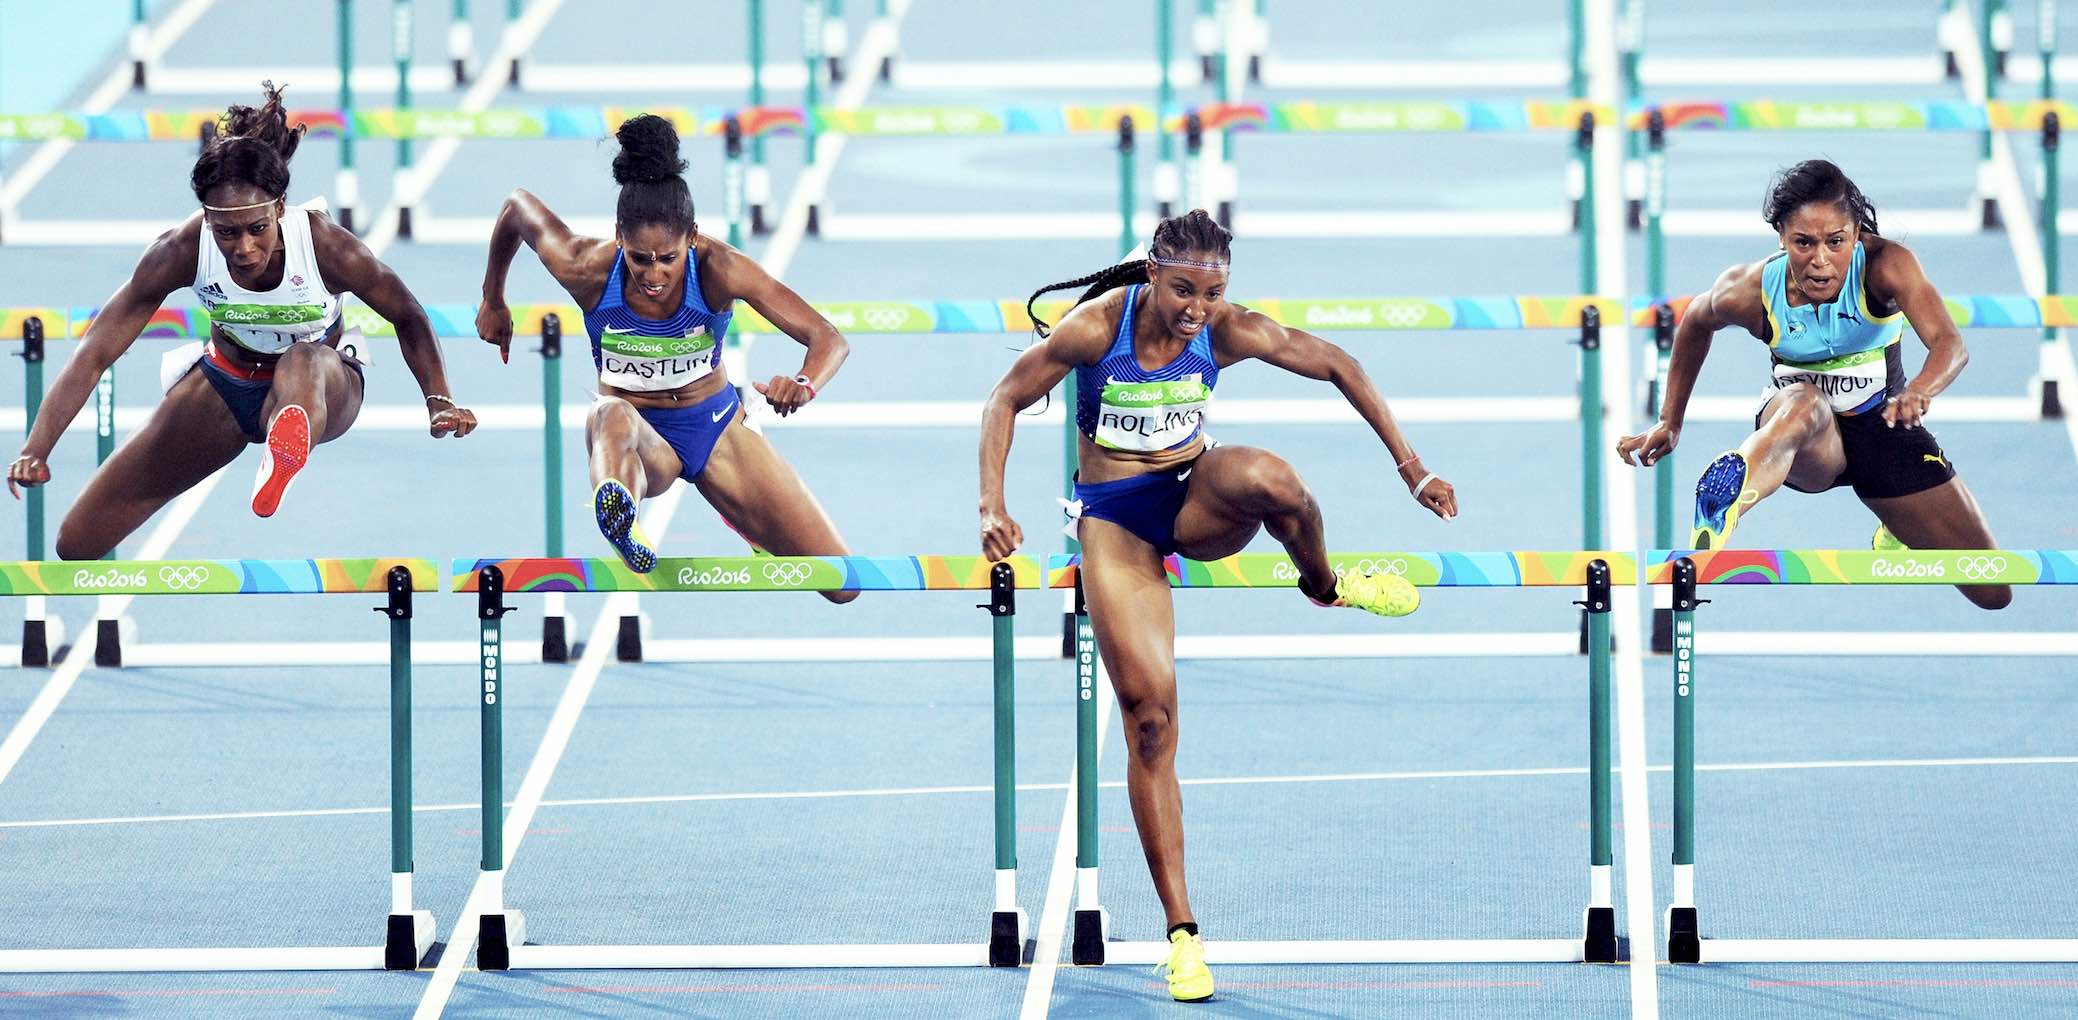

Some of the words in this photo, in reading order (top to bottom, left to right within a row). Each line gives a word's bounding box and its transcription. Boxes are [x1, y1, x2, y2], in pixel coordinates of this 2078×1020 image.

[225, 309, 271, 320] Rio2016
[617, 340, 664, 352] Rio2016
[1118, 388, 1164, 402] Rio2016
[678, 566, 751, 585] Rio2016
[1872, 558, 1945, 578] Rio2016
[73, 568, 148, 589] Rio2016
[483, 644, 498, 705] MONDO
[1079, 640, 1094, 701] MONDO
[1676, 636, 1692, 697] MONDO
